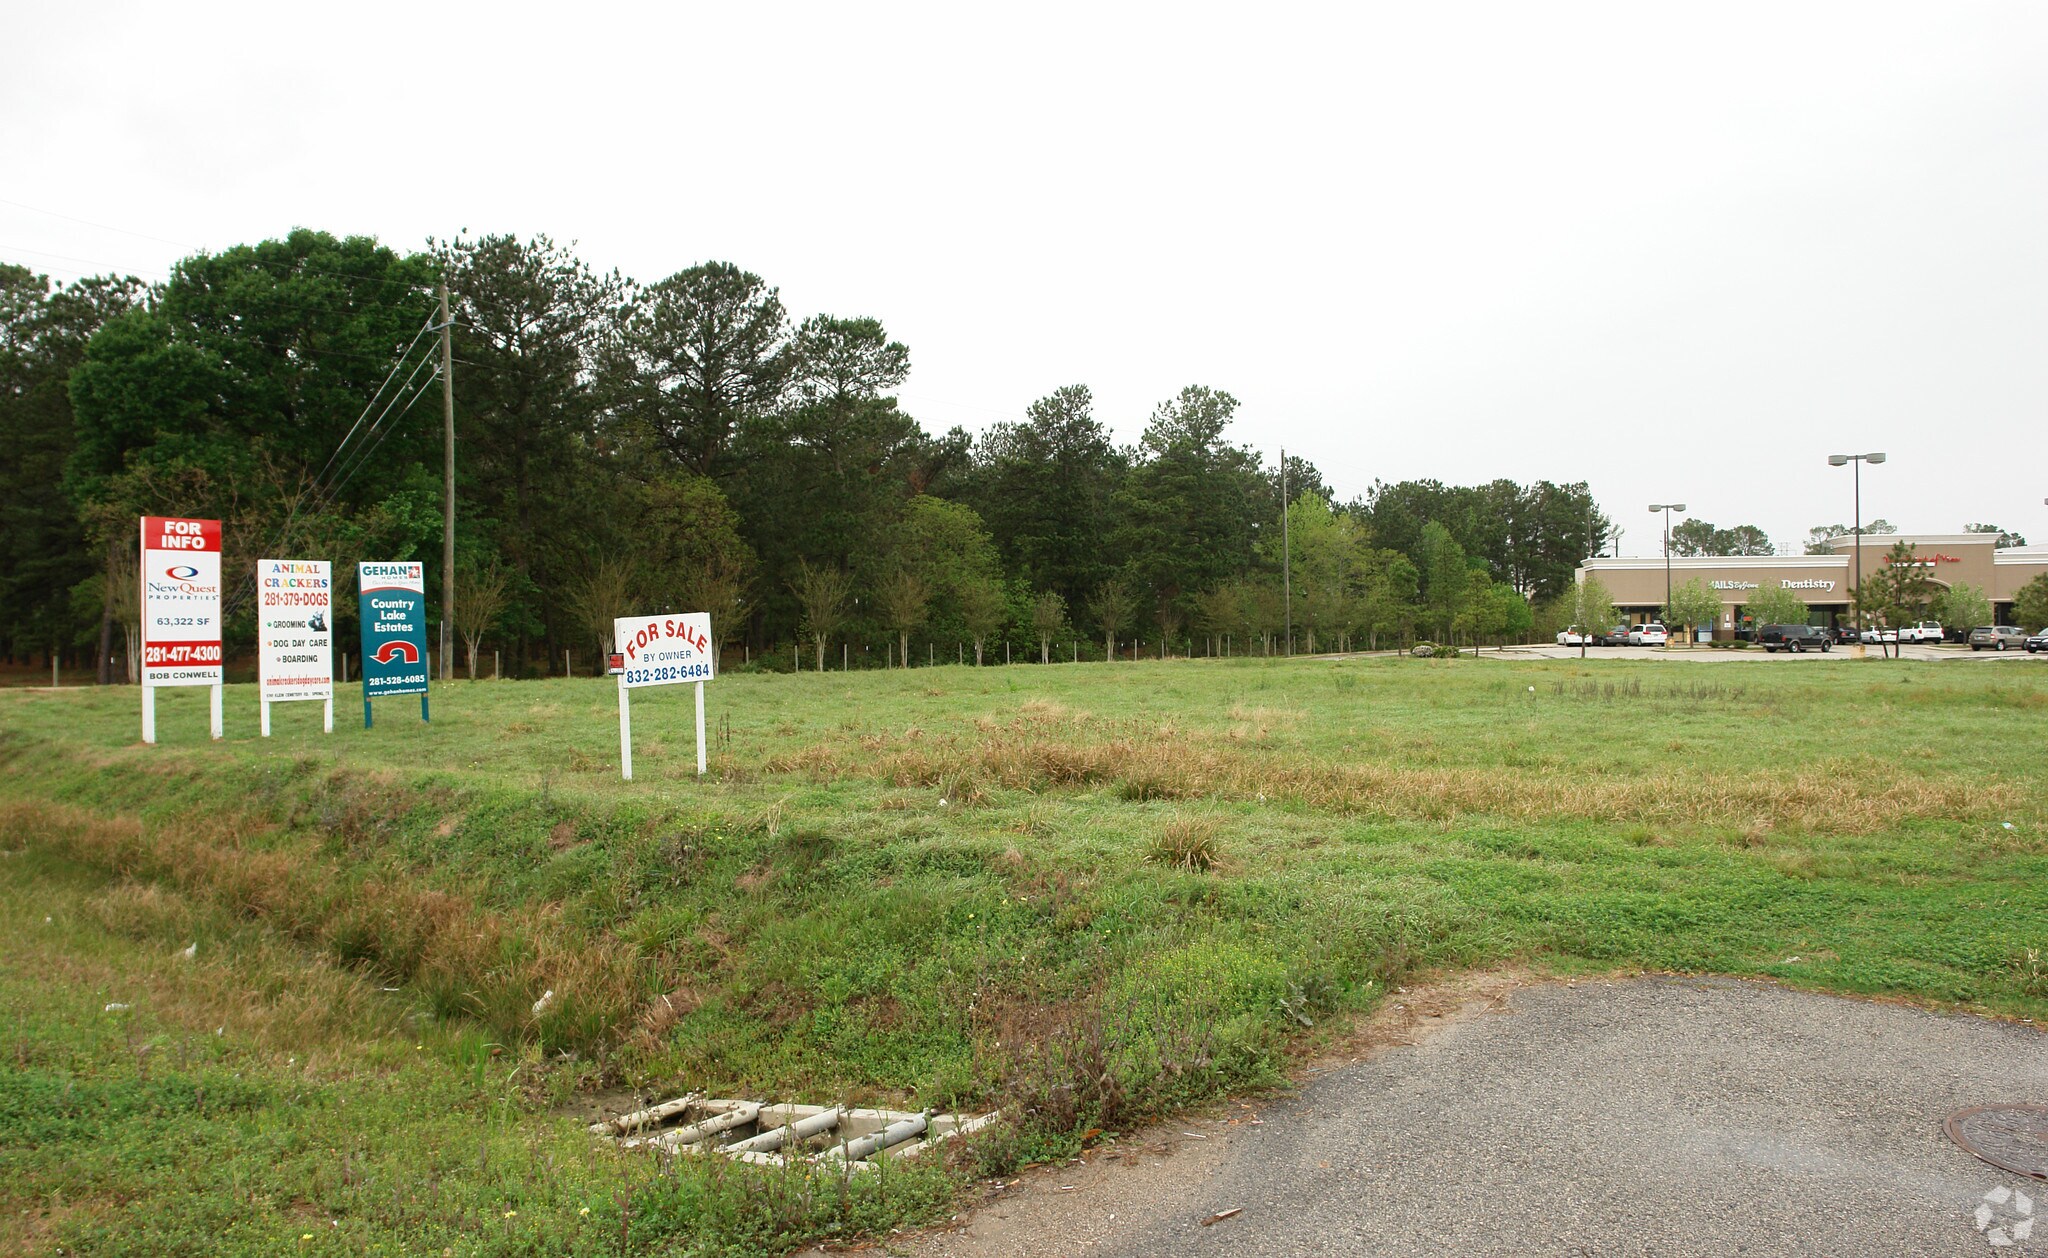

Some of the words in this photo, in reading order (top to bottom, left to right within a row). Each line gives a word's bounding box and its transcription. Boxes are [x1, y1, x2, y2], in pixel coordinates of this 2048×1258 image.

[164, 521, 202, 535] FOR
[162, 535, 205, 549] INFO
[272, 564, 320, 573] ANIMAL
[362, 566, 407, 576] GEHAN
[264, 578, 328, 588] CRACKERS
[1781, 579, 1836, 592] Dentistry
[371, 598, 414, 610] Country
[381, 610, 406, 620] Lake
[156, 618, 193, 626] 63,322
[374, 622, 413, 632] Estates
[626, 623, 659, 660] FOR
[665, 620, 707, 654] SALE
[146, 646, 220, 662] 281-477-4300
[282, 655, 318, 663] BOARDING
[644, 654, 655, 662] BY
[659, 650, 692, 660] OWNER
[369, 675, 425, 686] 281-528-6085
